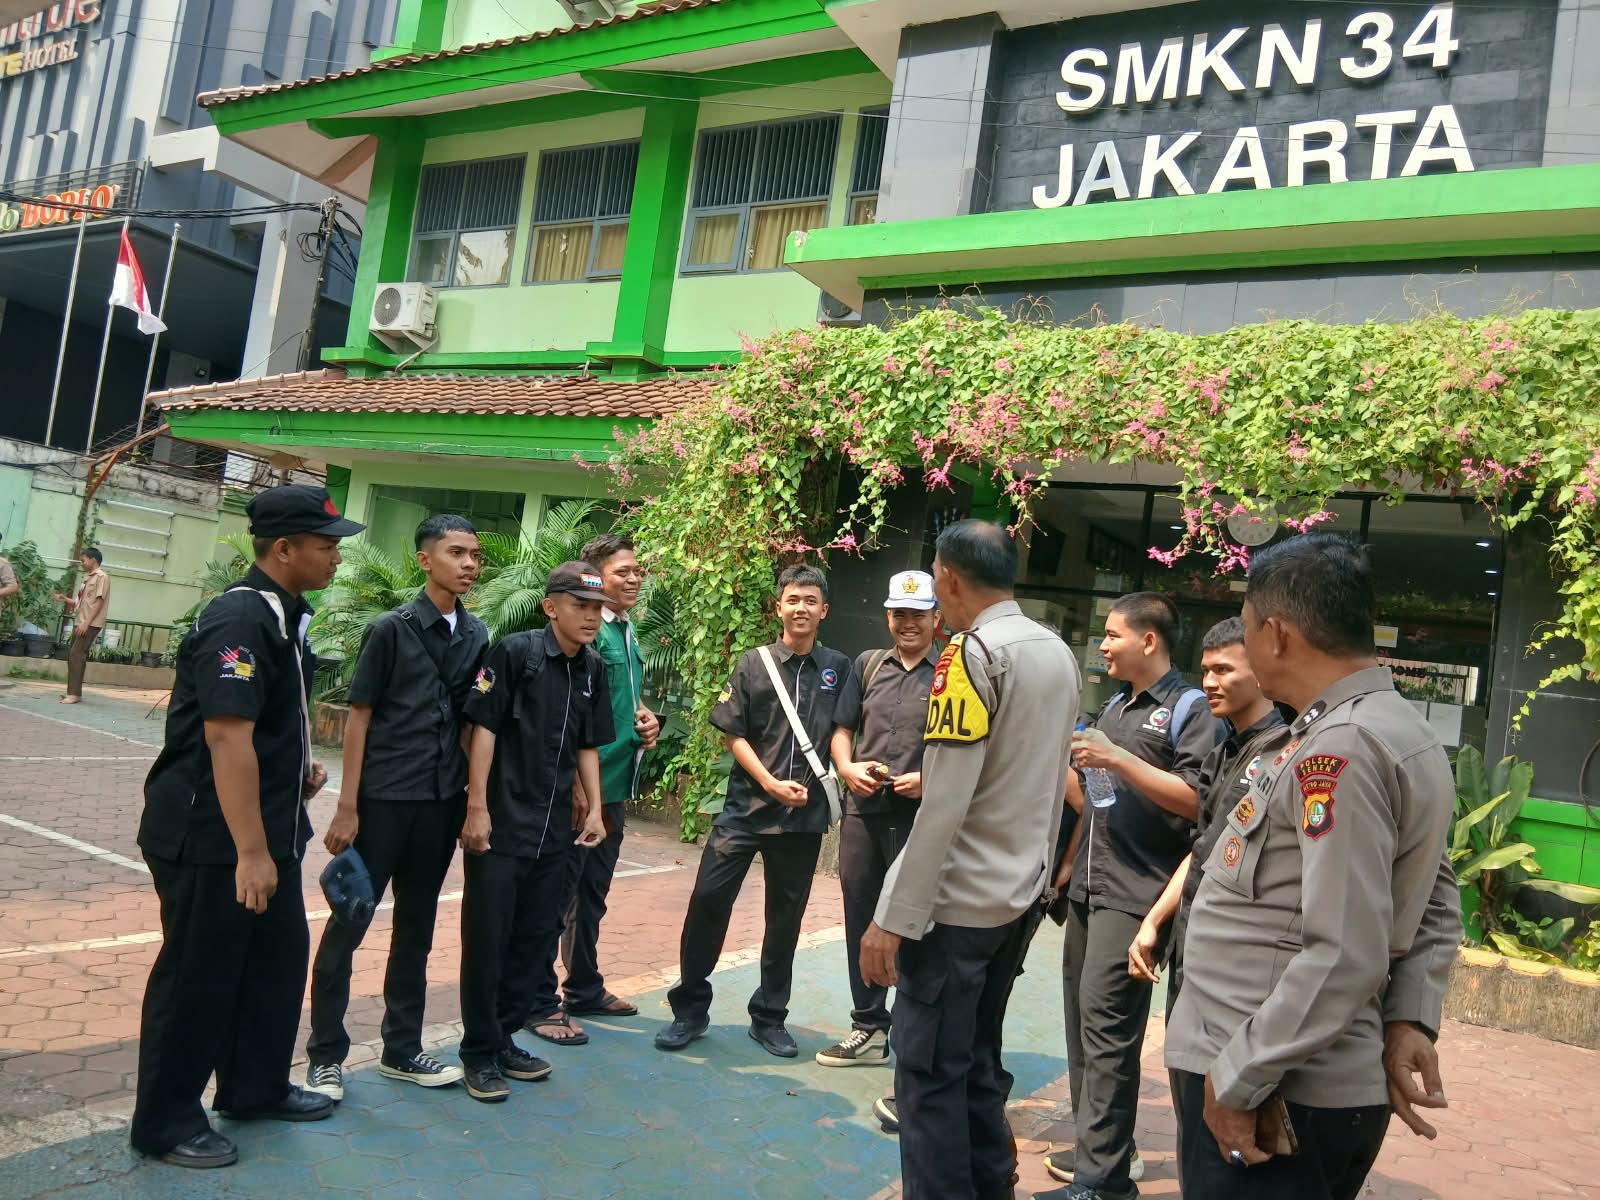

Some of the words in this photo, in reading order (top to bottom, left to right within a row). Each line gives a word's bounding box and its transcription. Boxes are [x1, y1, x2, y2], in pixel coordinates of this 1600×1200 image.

[21, 39, 79, 73] HOTEL
[1055, 18, 1323, 114] SMKN
[1340, 3, 1459, 81] 34
[1032, 104, 1475, 209] JAKARTA
[926, 697, 971, 737] DAL
[1300, 756, 1338, 770] POLSEK
